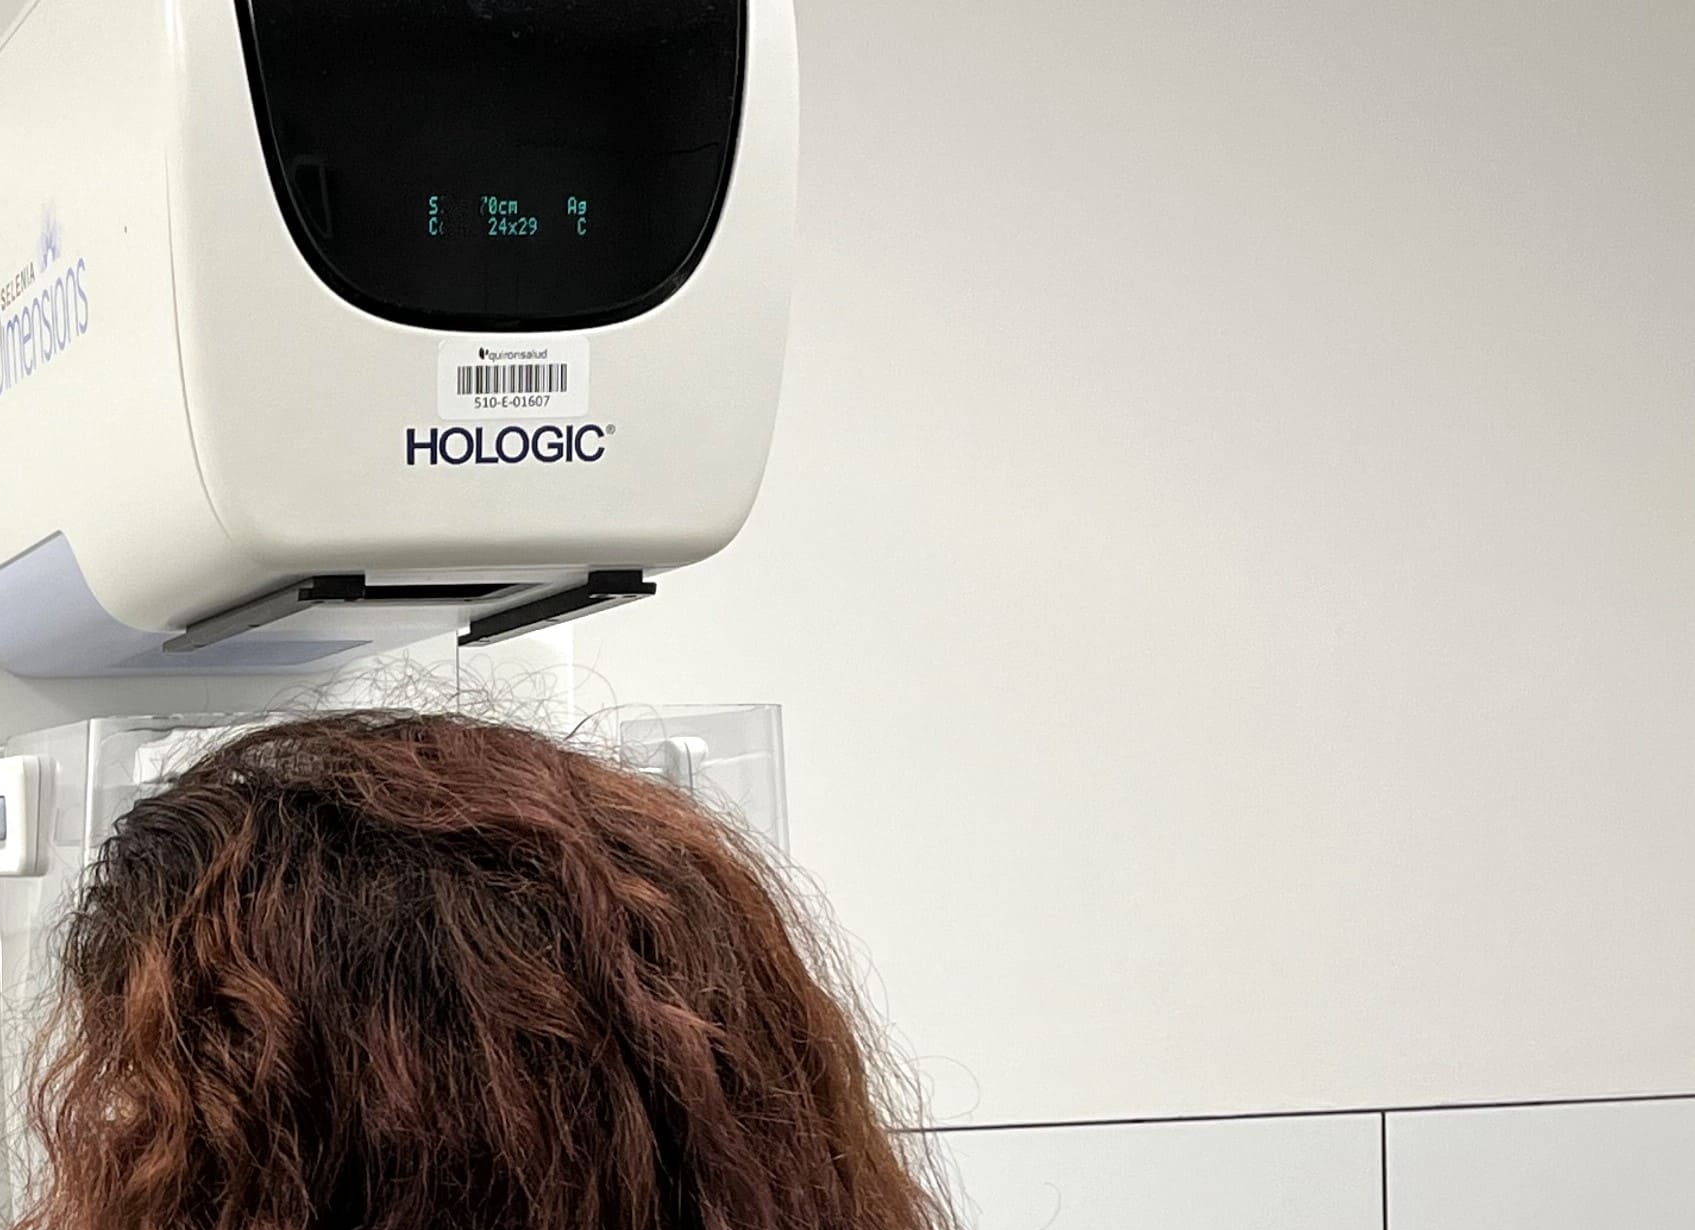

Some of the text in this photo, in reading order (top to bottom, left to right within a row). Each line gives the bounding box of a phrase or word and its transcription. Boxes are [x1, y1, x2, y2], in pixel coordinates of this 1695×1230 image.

[487, 217, 538, 236] 24x29
[576, 217, 587, 236] C
[0, 261, 36, 311] SELENIA
[474, 395, 551, 409] 510-E-01607
